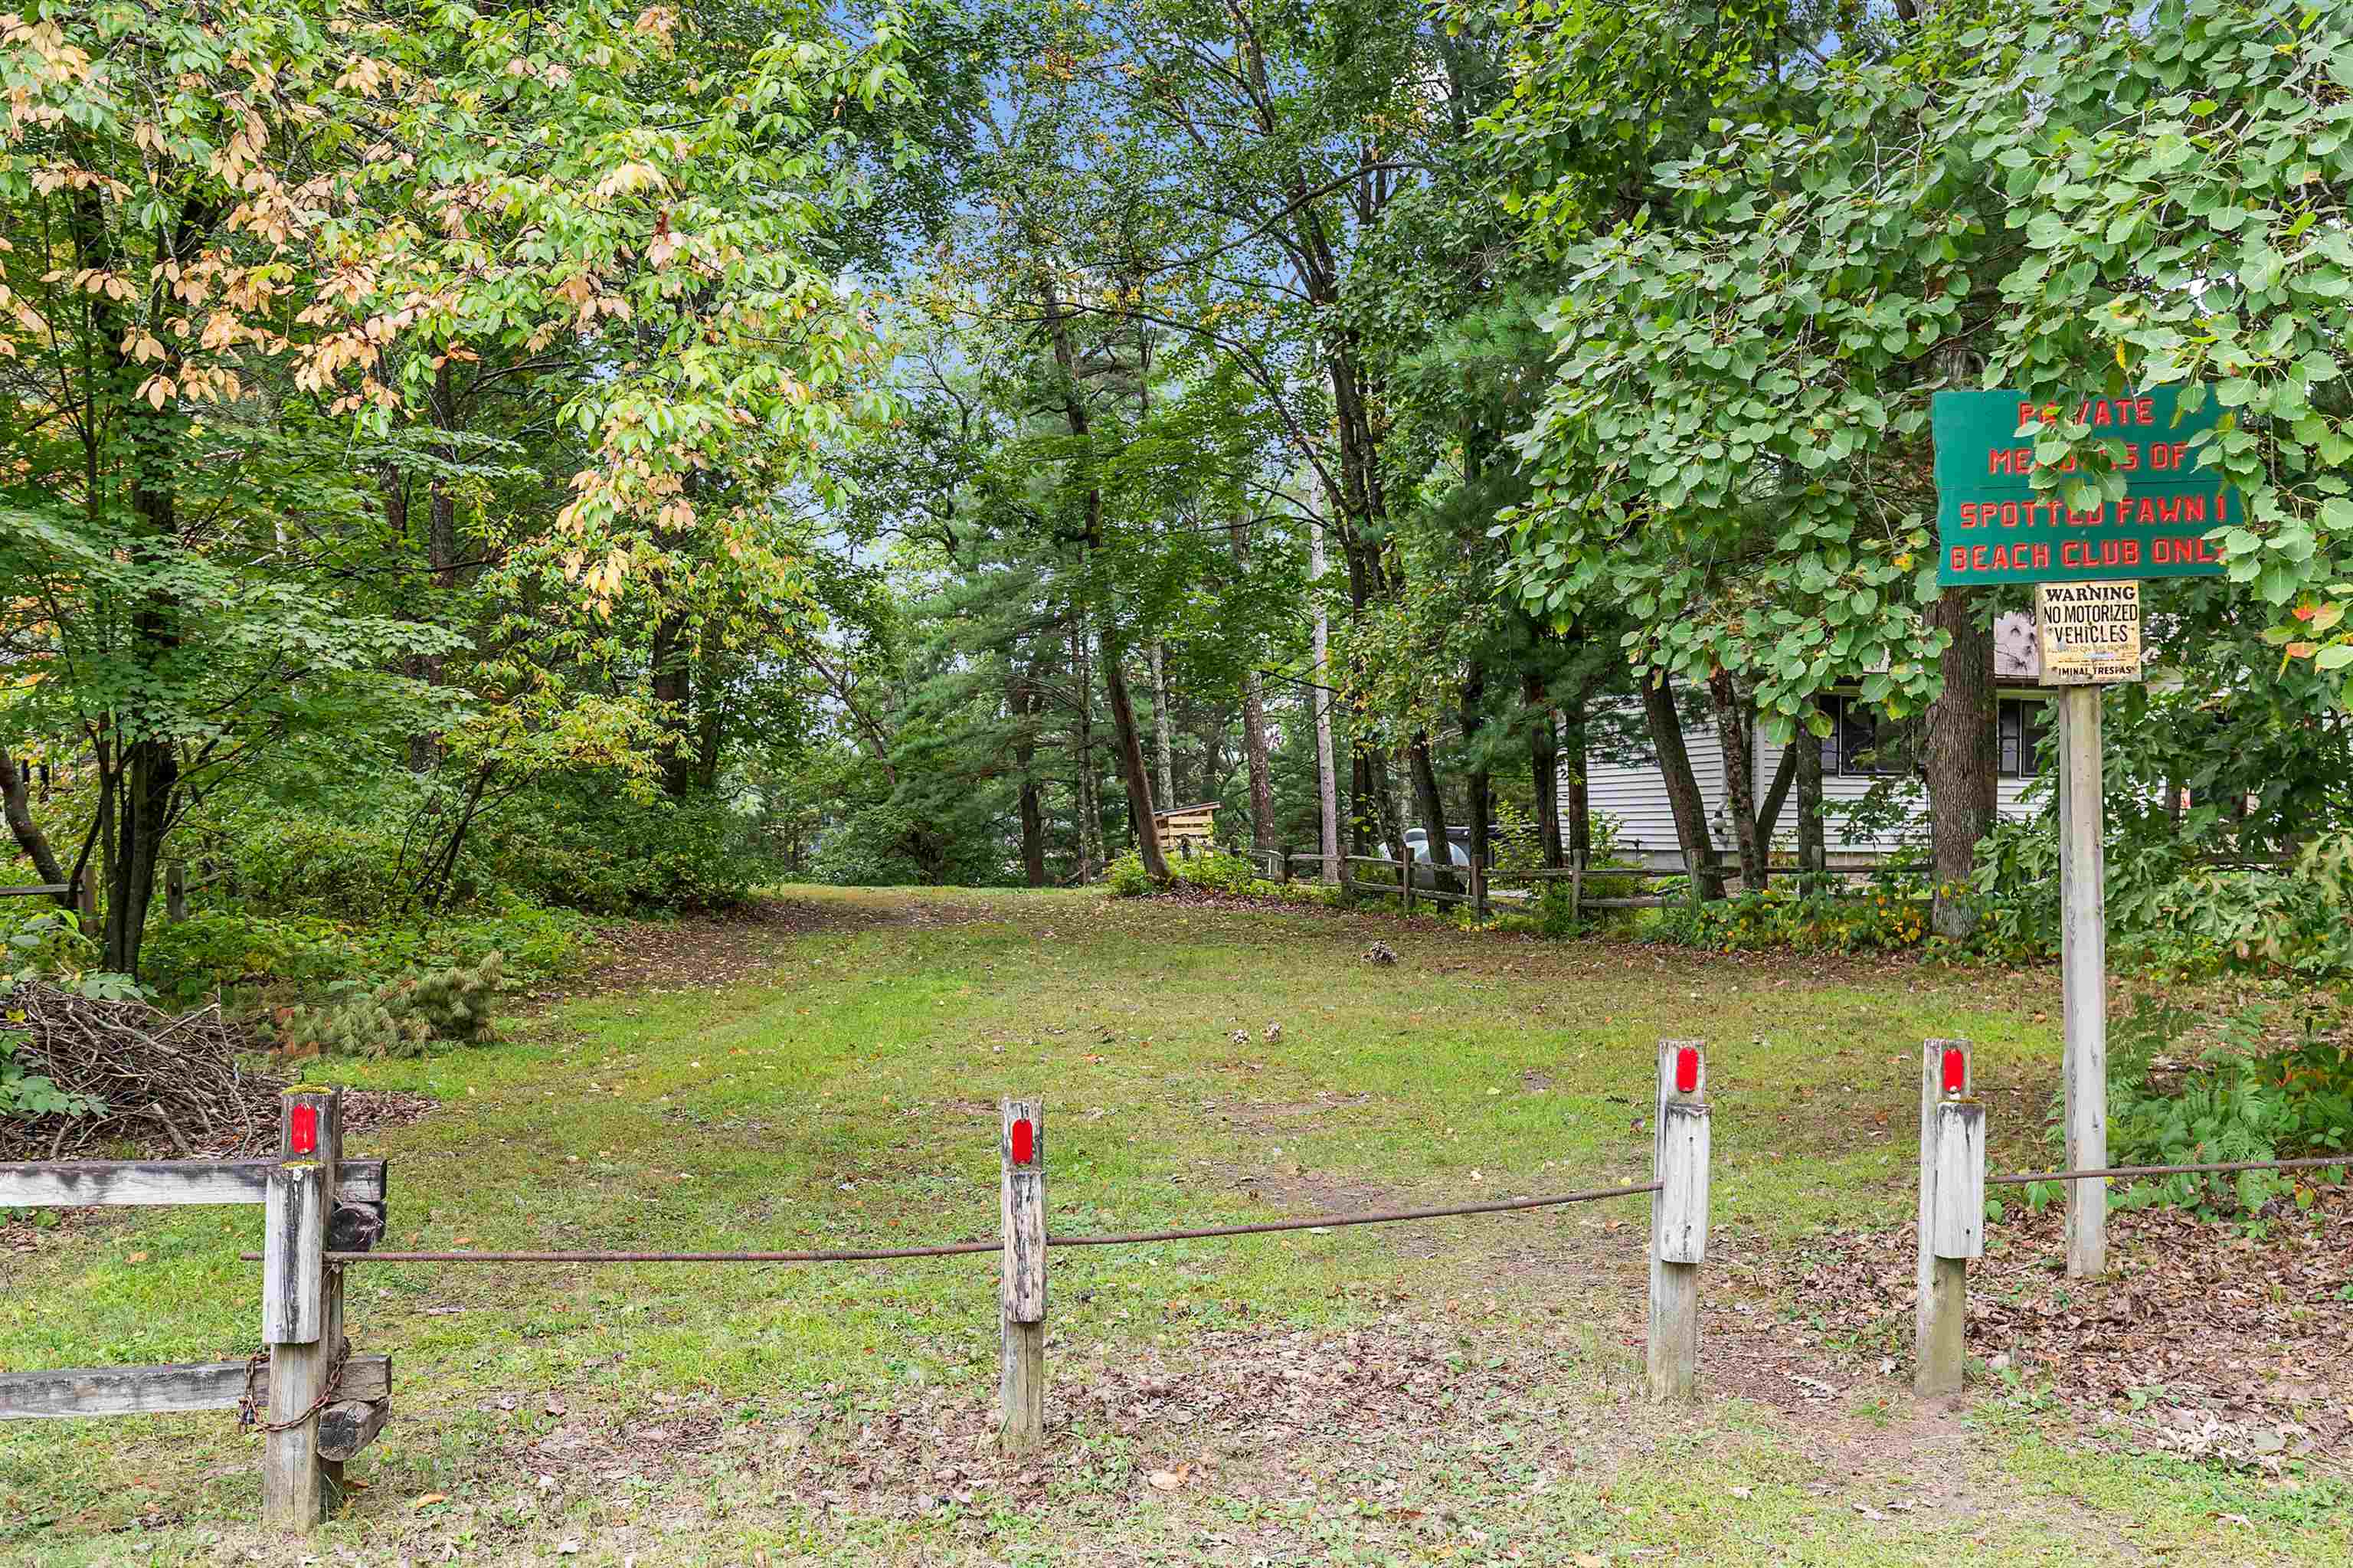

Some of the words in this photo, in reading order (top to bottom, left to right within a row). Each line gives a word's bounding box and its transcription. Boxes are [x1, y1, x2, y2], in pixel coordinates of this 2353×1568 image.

[2150, 441, 2188, 470] OF
[2117, 495, 2205, 525] FAWN
[1951, 542, 2050, 571] BEACH
[2062, 538, 2139, 567] CLUB
[2045, 587, 2135, 602] WARNING
[2044, 606, 2061, 624] NO
[2064, 604, 2138, 623] MOTORIZED
[2054, 624, 2128, 643] VEHICLES
